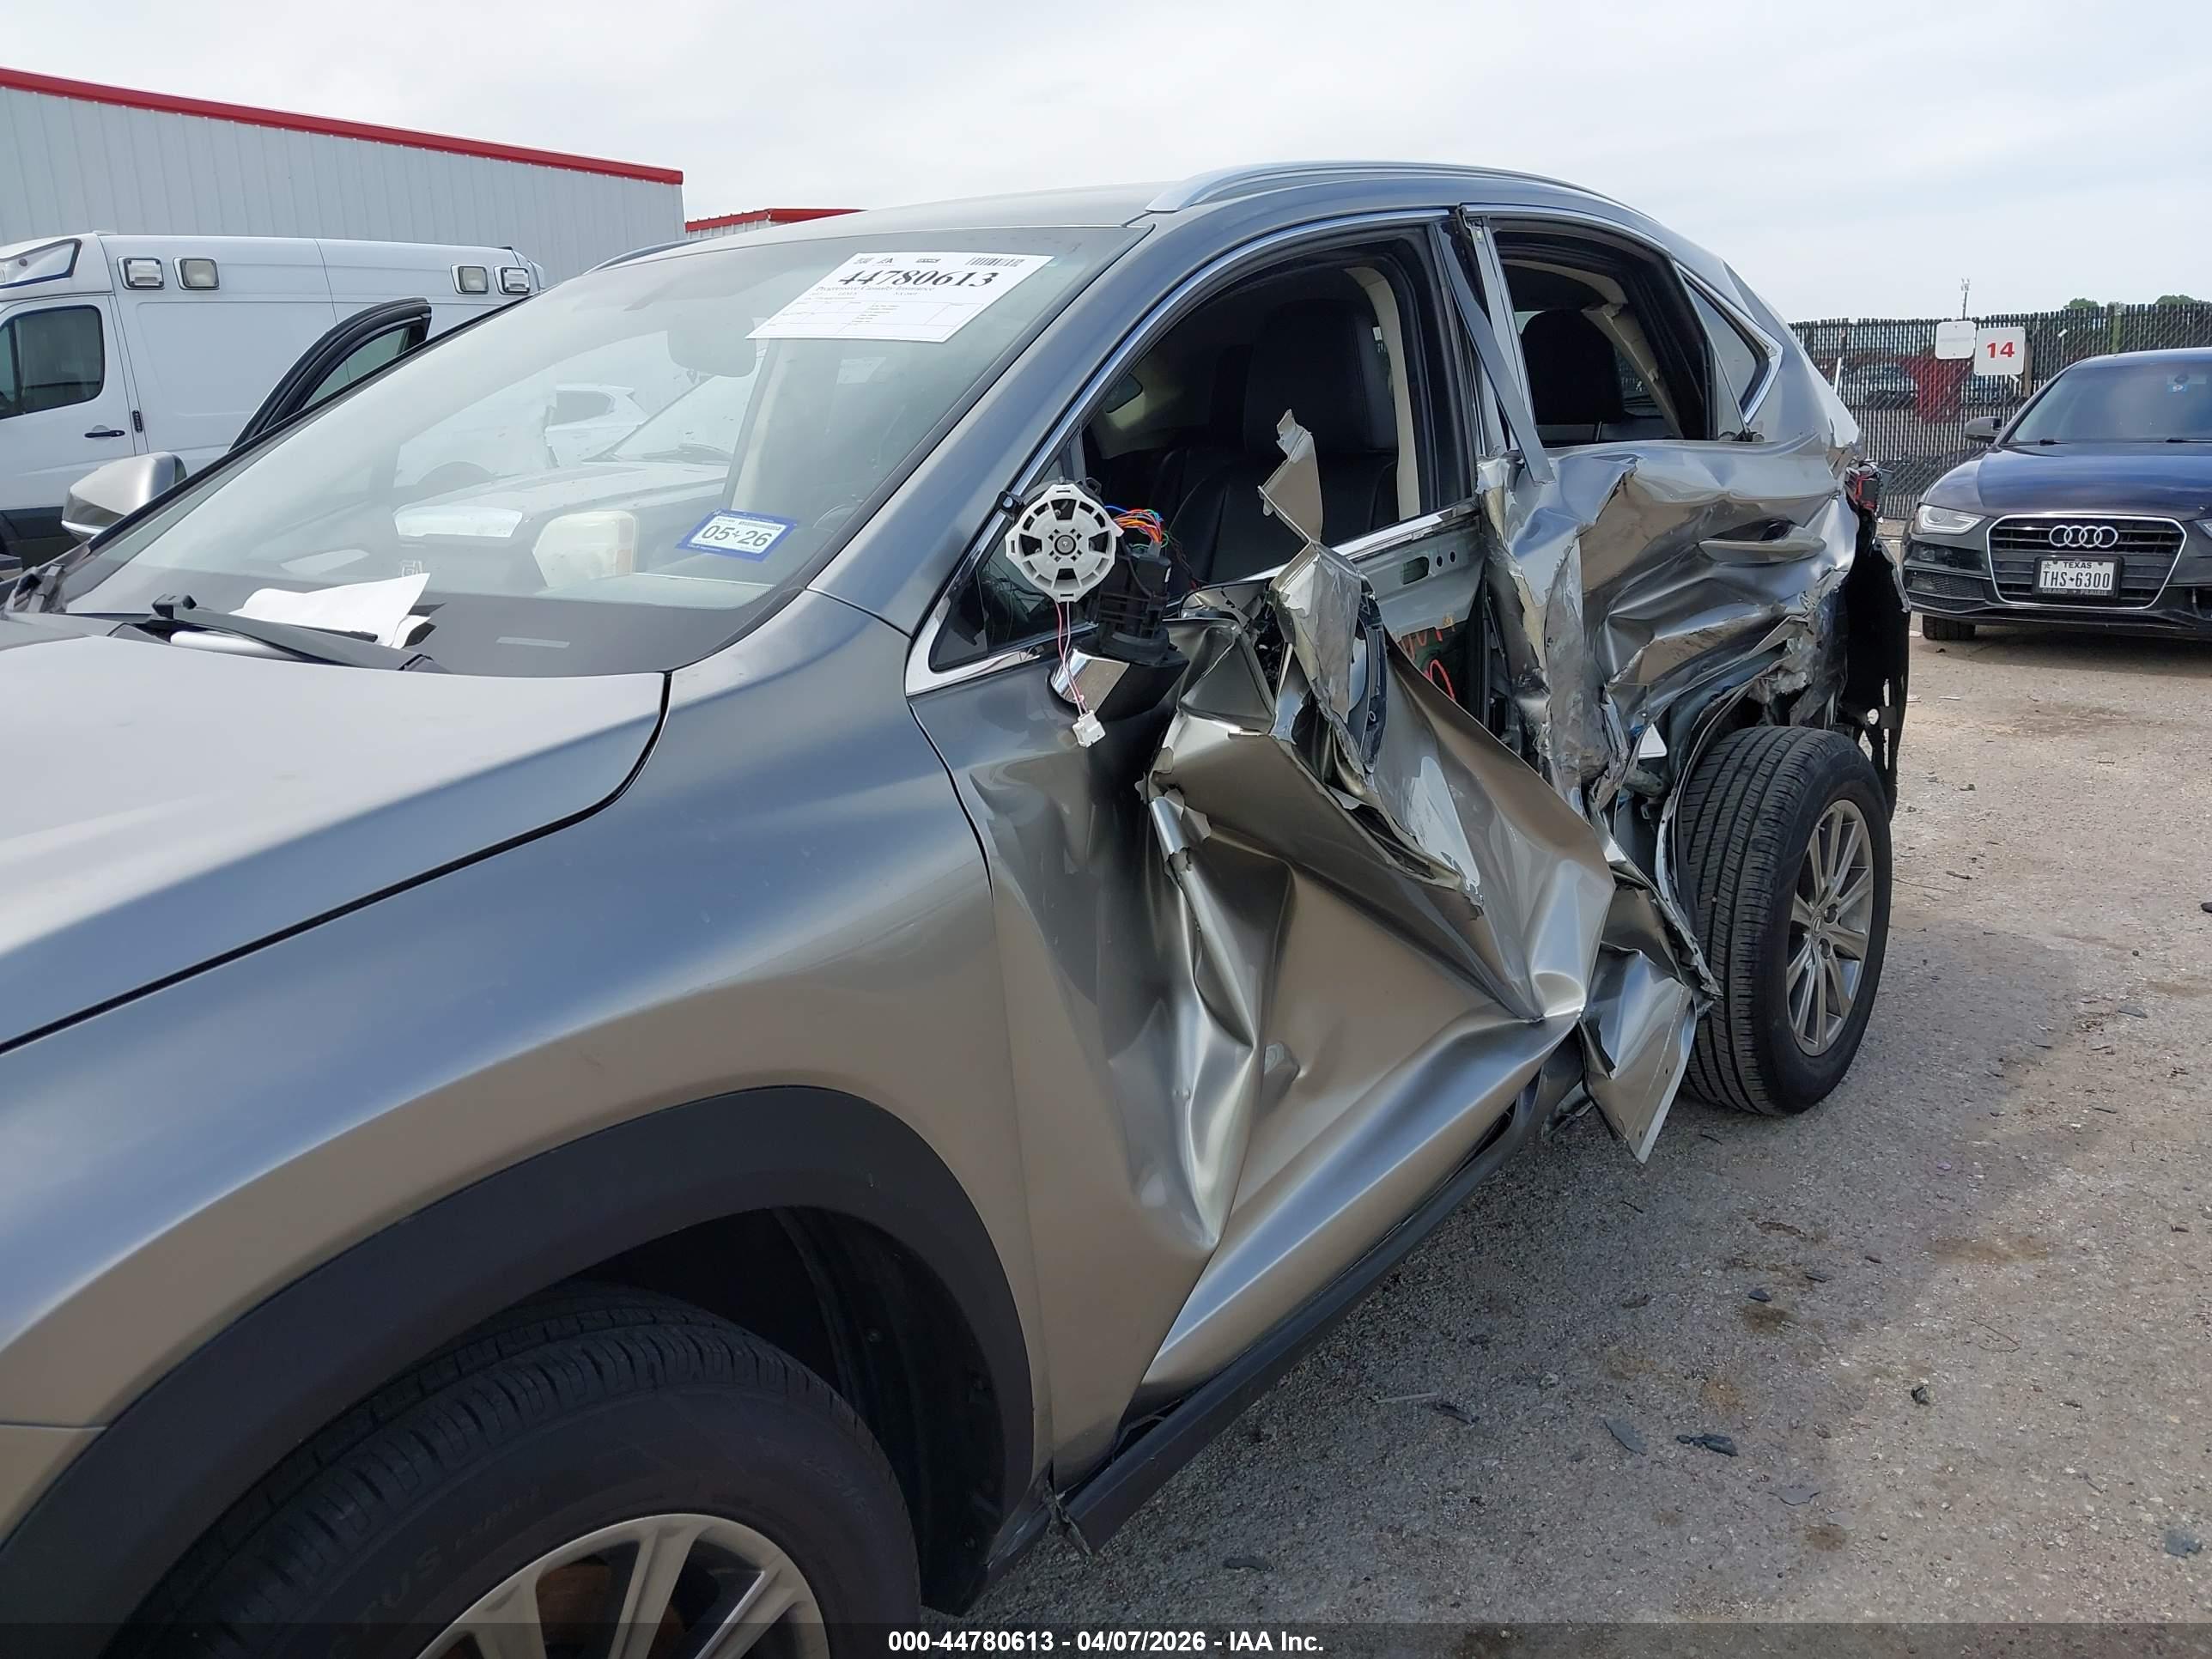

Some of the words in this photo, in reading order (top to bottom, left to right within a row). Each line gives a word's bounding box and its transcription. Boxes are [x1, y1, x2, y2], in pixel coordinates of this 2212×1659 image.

[838, 270, 1000, 287] 44780613
[1987, 341, 2015, 358] 14
[702, 525, 735, 541] 05
[737, 530, 772, 547] 26
